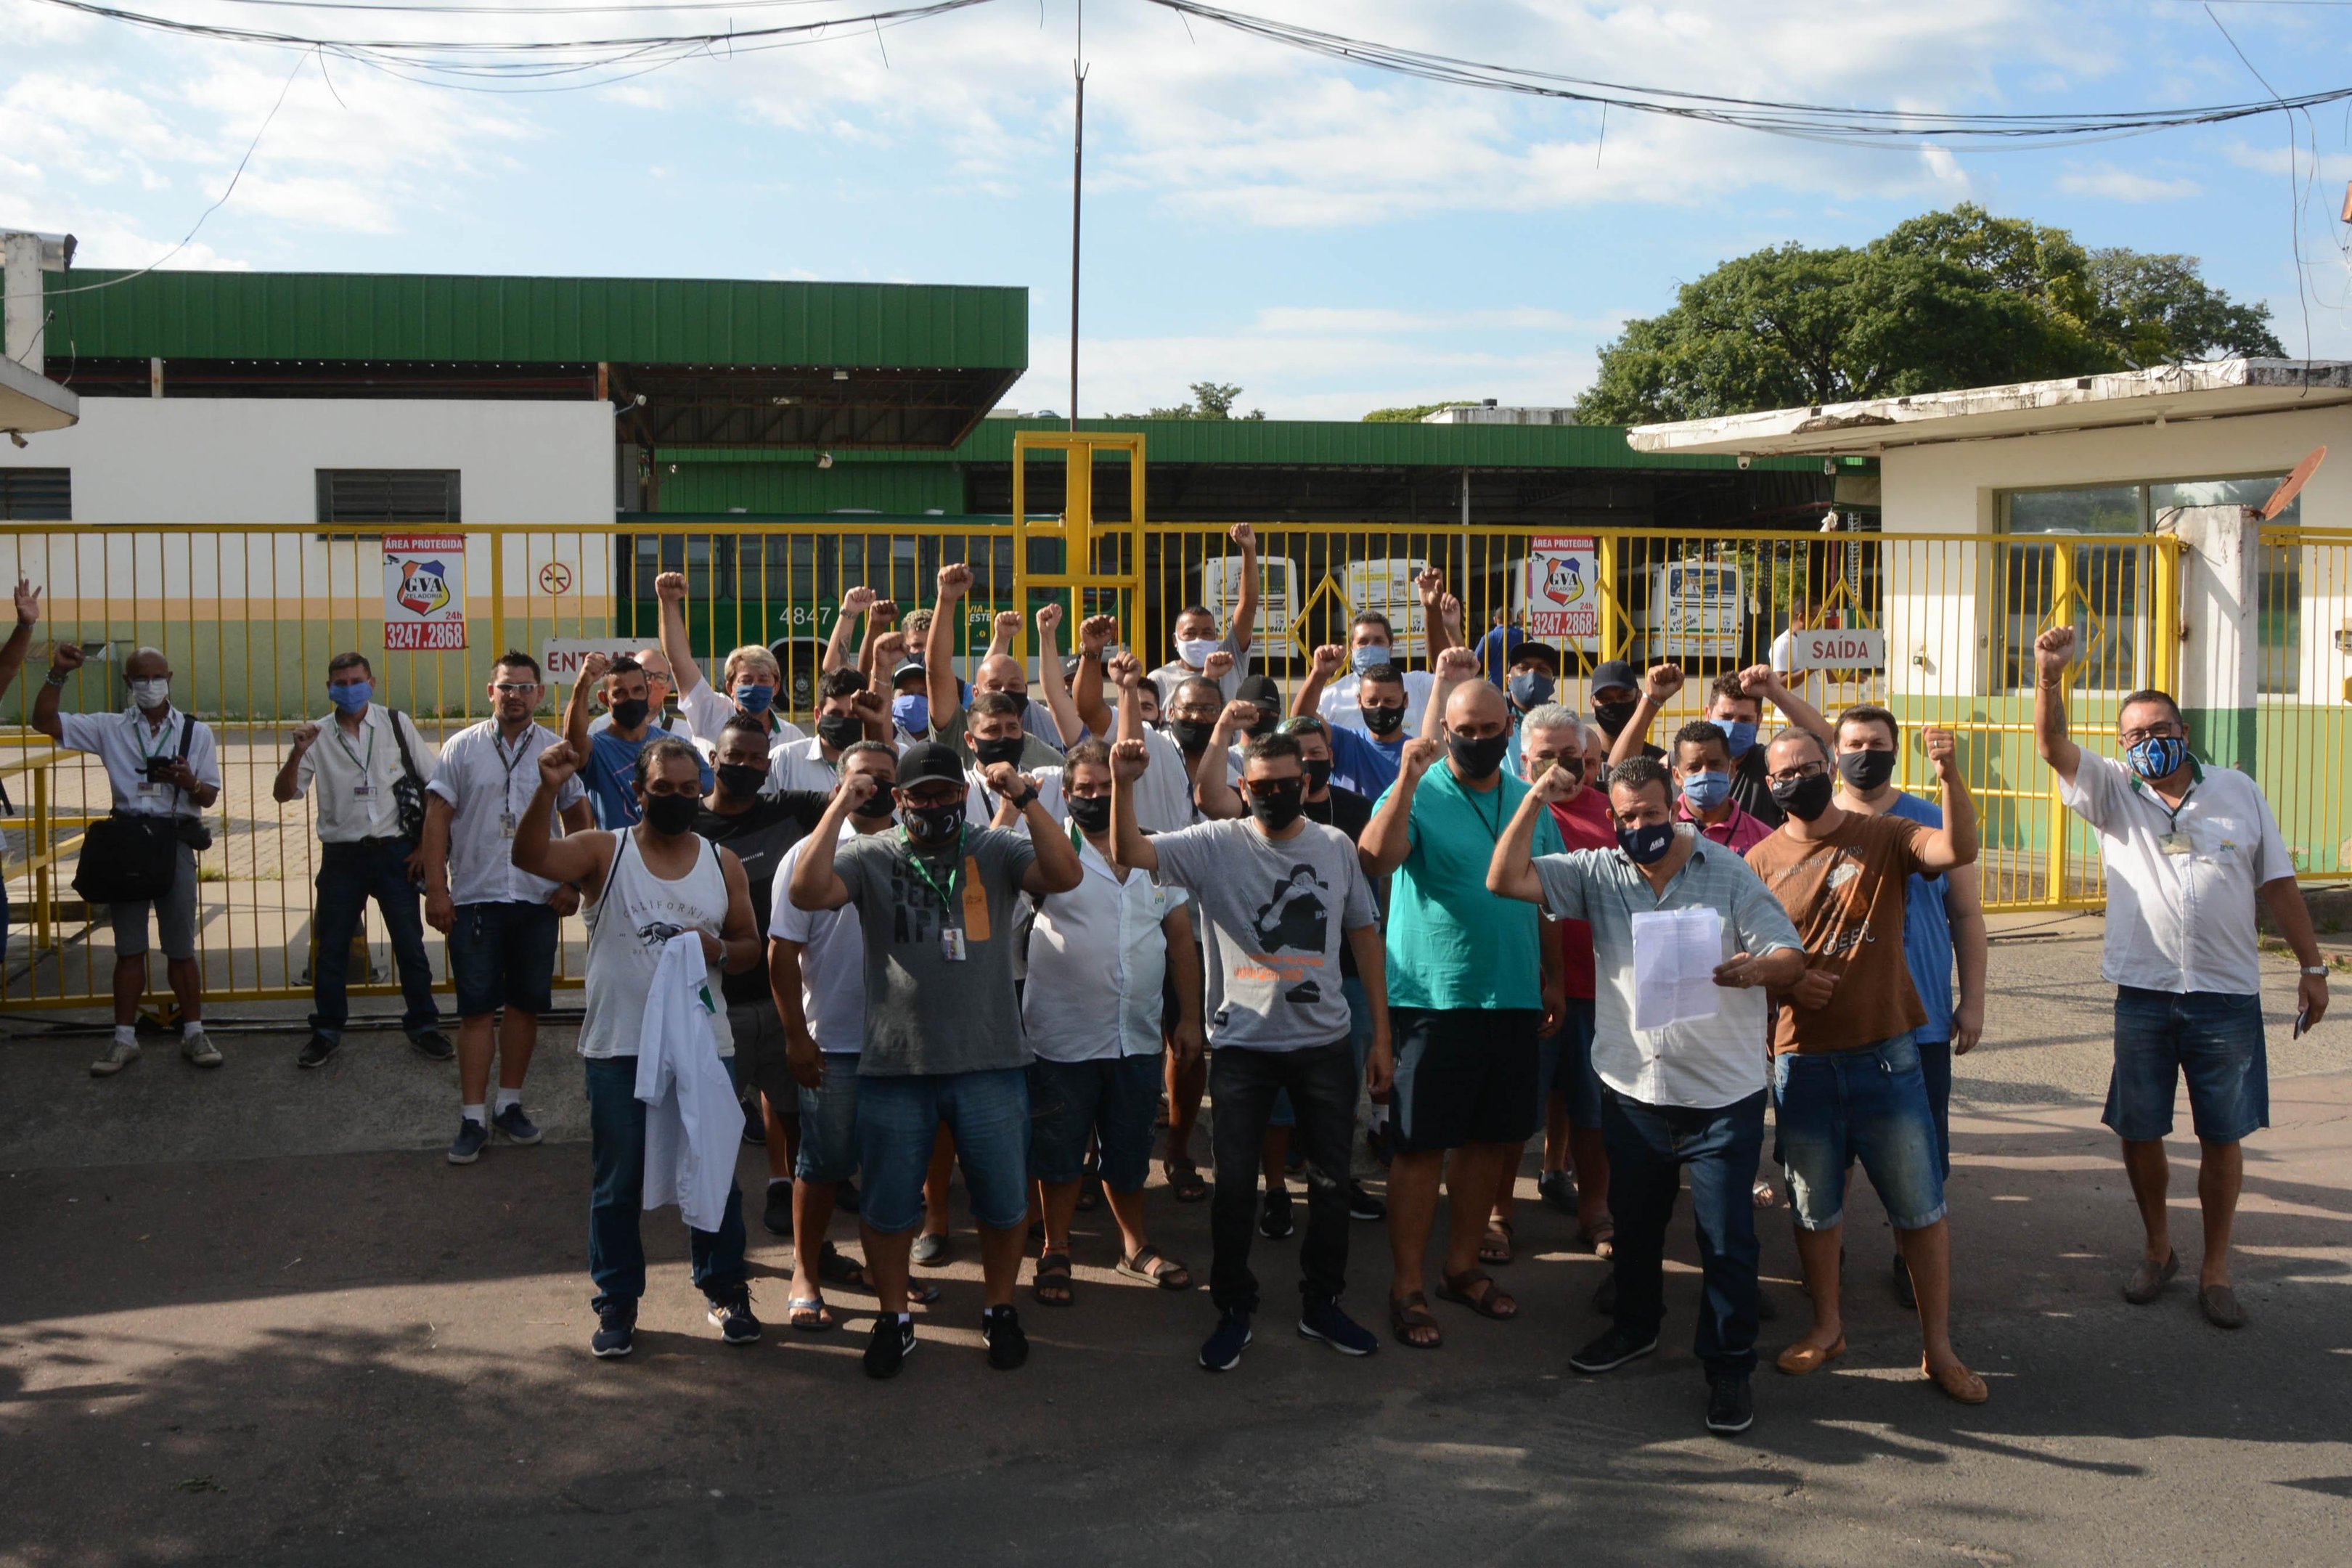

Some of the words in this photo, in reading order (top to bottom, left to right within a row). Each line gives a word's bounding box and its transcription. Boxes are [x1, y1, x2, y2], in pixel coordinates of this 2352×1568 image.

[385, 537, 409, 550] ÁREA
[412, 539, 462, 550] PROTEGIDA
[1532, 538, 1552, 548] ÁREA
[1554, 539, 1593, 548] PROTEGIDA
[405, 577, 443, 593] GVA
[1549, 572, 1578, 586] GVA
[1580, 602, 1593, 611] 24h
[446, 611, 462, 620] 24h
[779, 607, 831, 625] 4847
[967, 613, 991, 622] ESTE
[1534, 613, 1593, 634] 3247.2868
[1675, 618, 1697, 632] ALGRE
[388, 623, 463, 649] 3247.2868
[1812, 634, 1869, 659] SAÍDA
[943, 809, 962, 833] 21
[623, 899, 710, 926] CALIFORNIA
